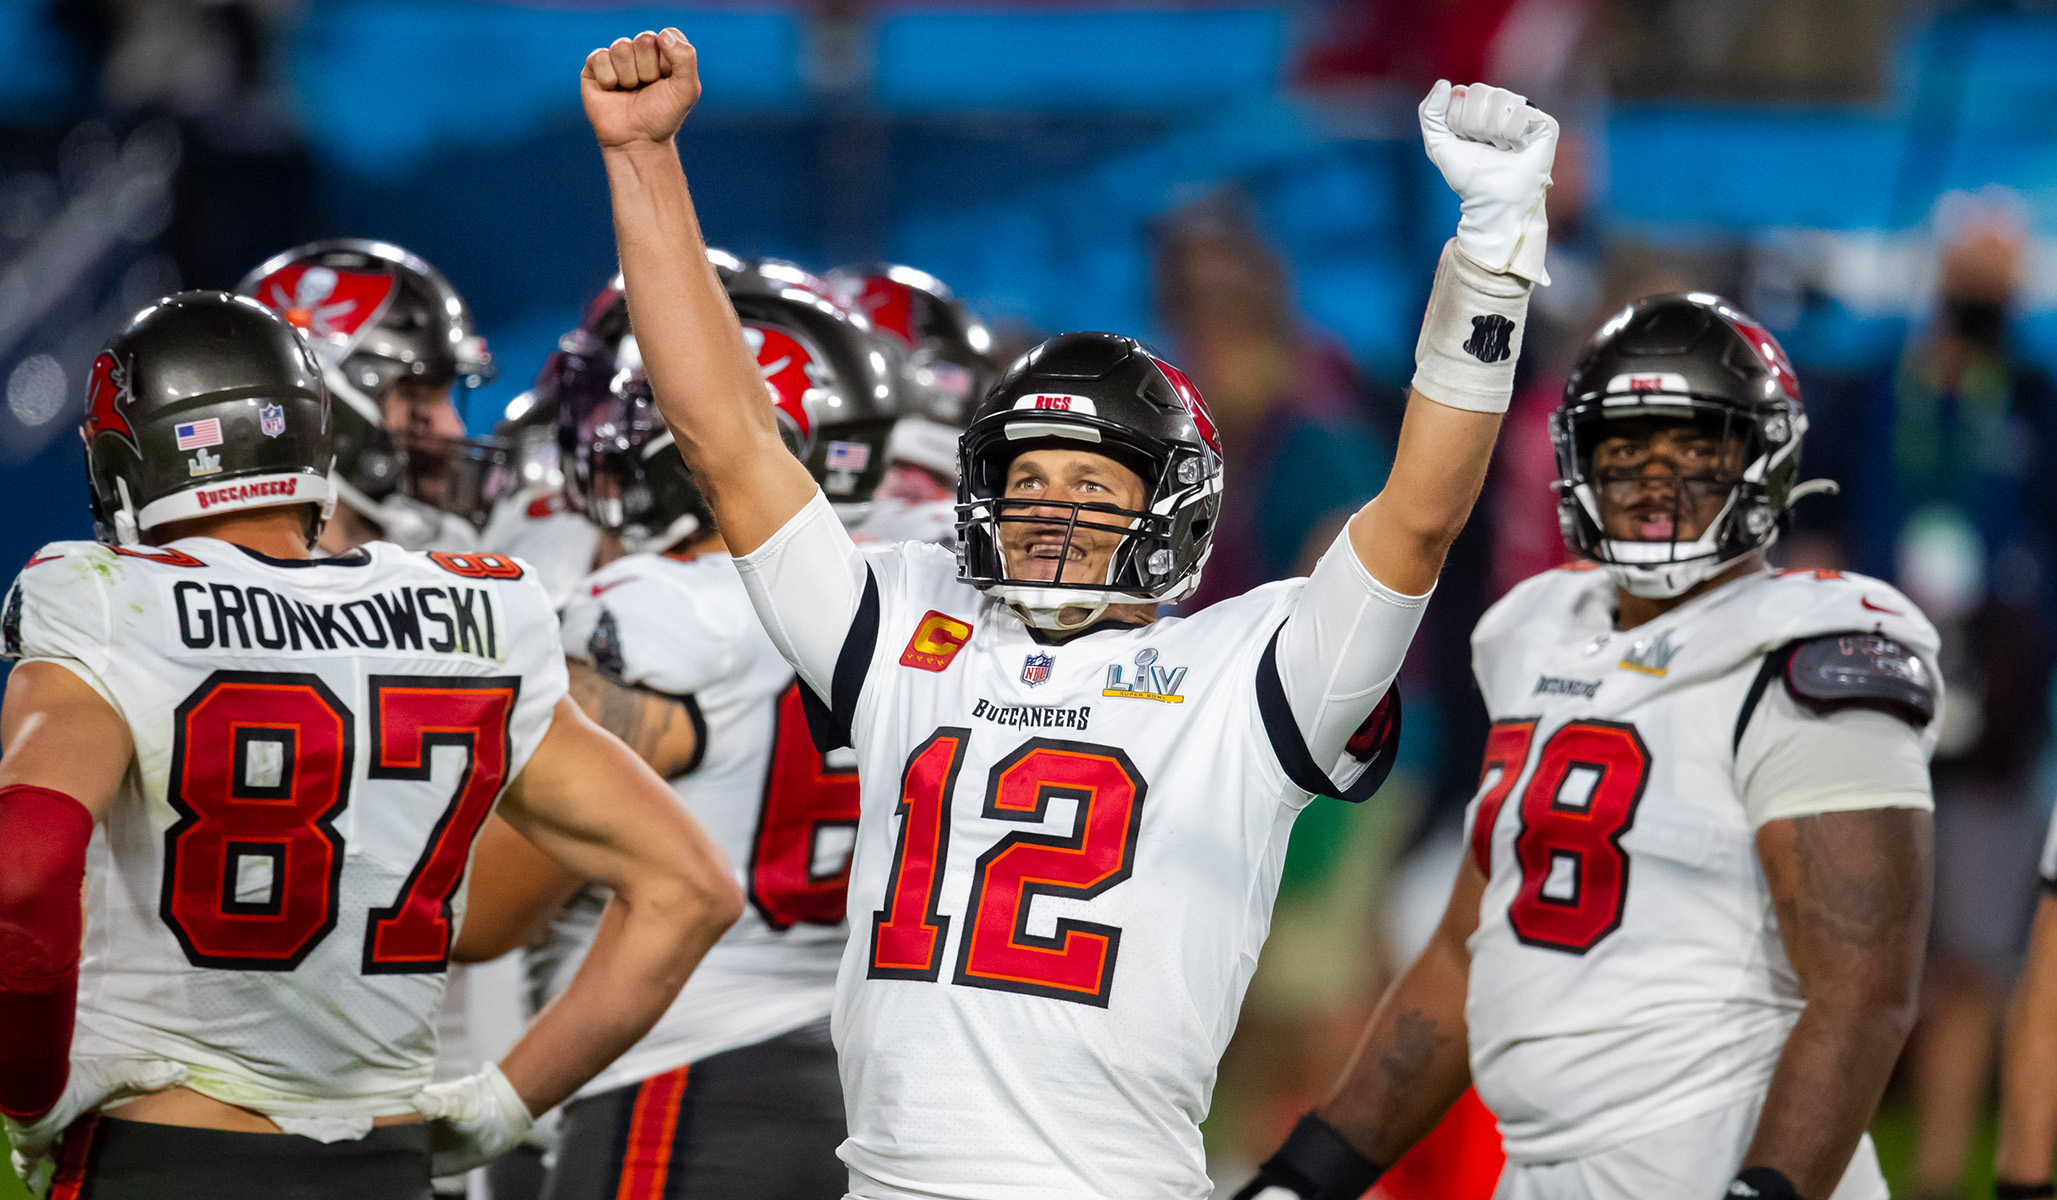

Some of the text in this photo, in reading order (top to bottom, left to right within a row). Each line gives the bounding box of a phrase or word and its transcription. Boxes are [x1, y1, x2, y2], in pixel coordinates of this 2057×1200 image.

[195, 477, 298, 508] BUCCANEERS
[173, 580, 496, 659] GRONKOWSKI
[913, 616, 969, 656] C
[1105, 648, 1188, 695] LIV
[971, 698, 1091, 731] BUCCANEERS
[160, 669, 522, 975] 87
[867, 726, 1149, 1010] 12
